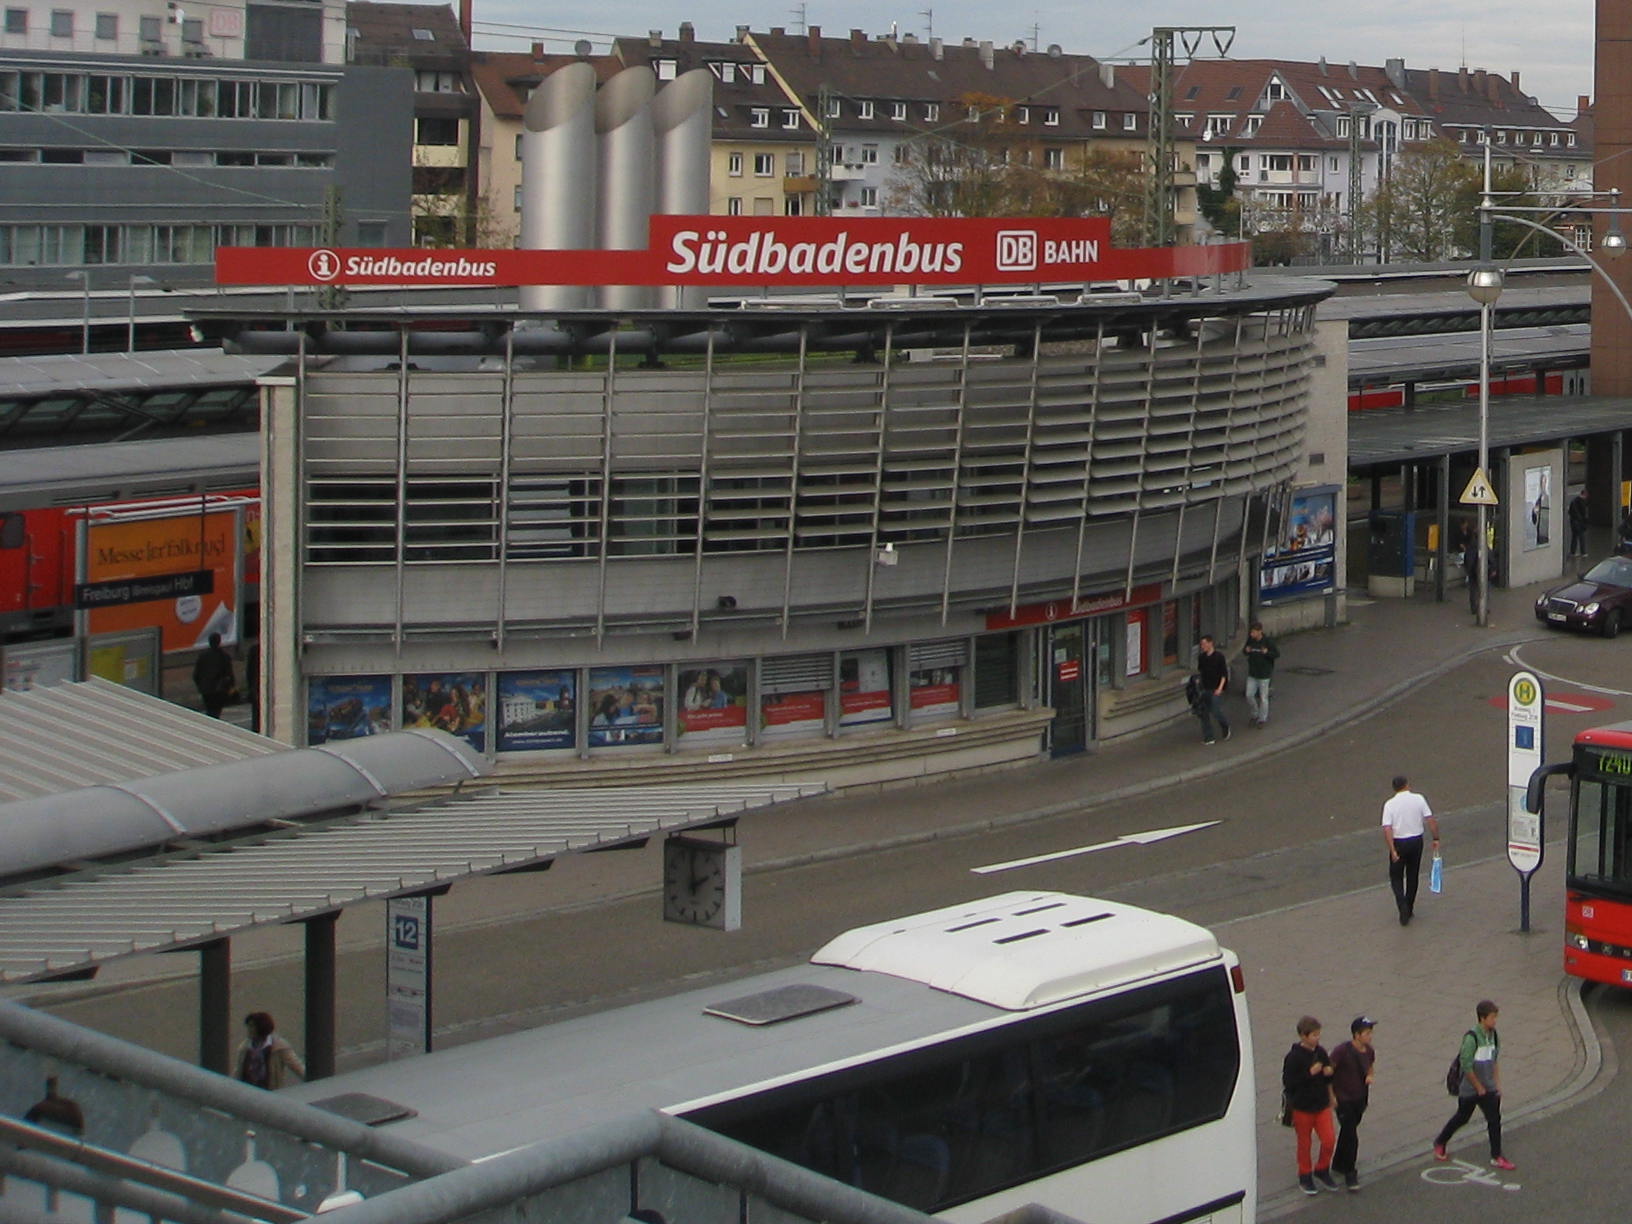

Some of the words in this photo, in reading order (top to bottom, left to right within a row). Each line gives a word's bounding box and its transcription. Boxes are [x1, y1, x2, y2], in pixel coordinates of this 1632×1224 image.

[667, 230, 964, 275] Südbadenbus
[1001, 236, 1033, 265] DB
[1044, 239, 1099, 264] BAHN
[345, 256, 497, 277] Südbadenbus
[83, 585, 130, 601] Freiburg
[175, 577, 193, 591] Hbf
[396, 919, 417, 944] 12
